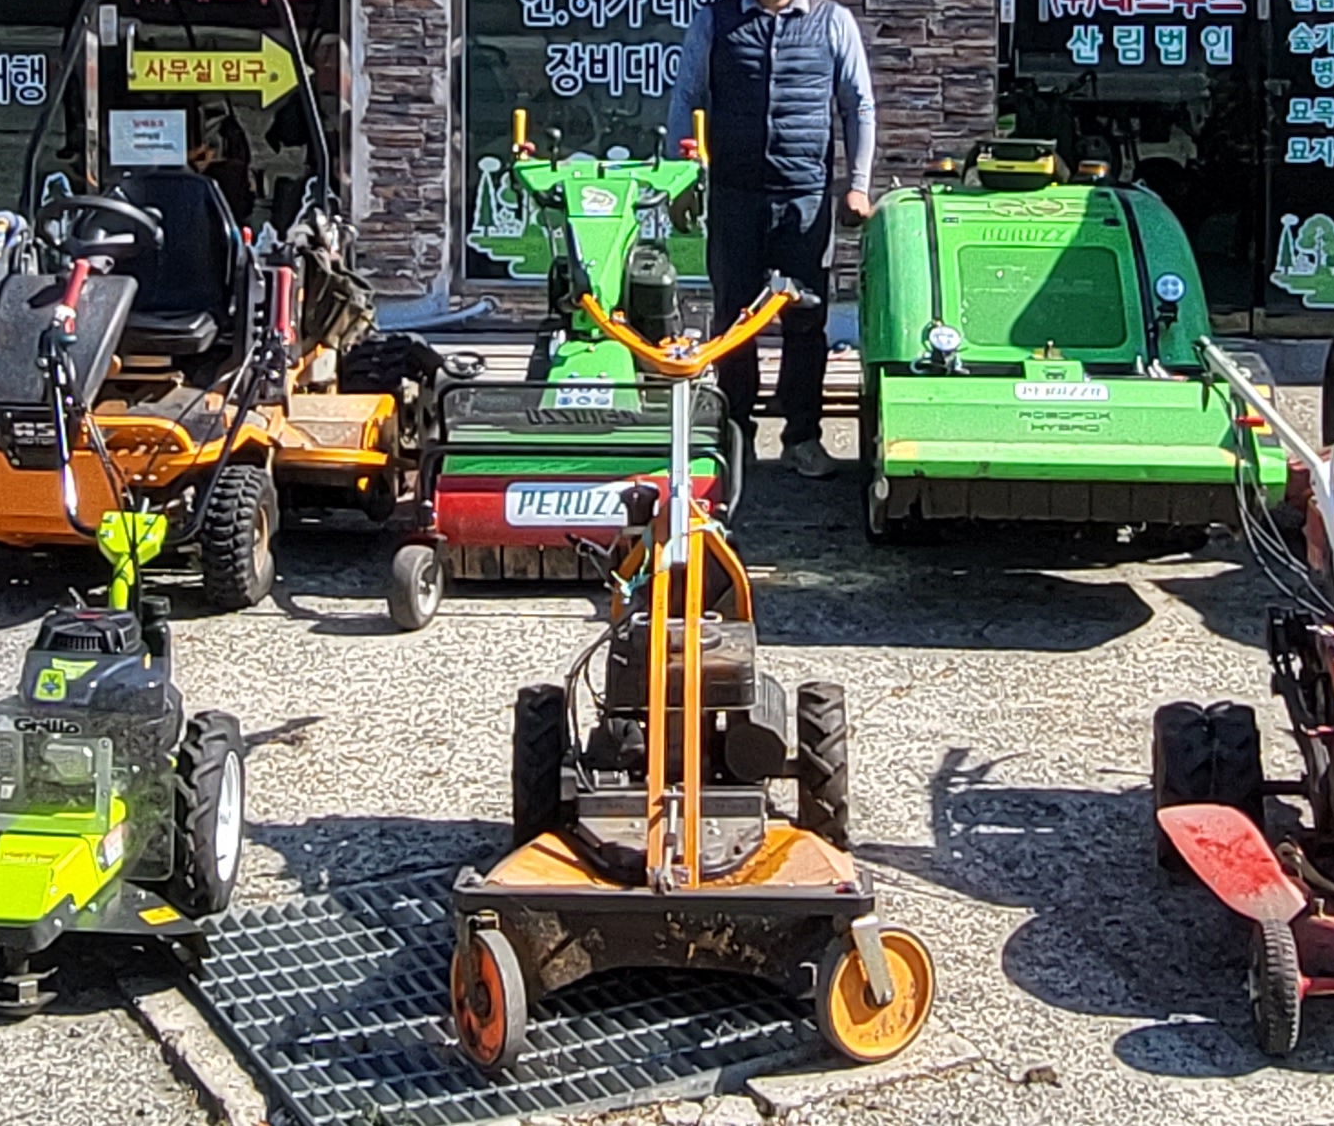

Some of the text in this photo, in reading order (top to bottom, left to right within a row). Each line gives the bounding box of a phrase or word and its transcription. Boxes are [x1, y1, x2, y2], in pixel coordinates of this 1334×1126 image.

[145, 59, 267, 84] 사무실 입구
[516, 490, 626, 516] PERUZZ
[13, 717, 81, 734] Grillo
